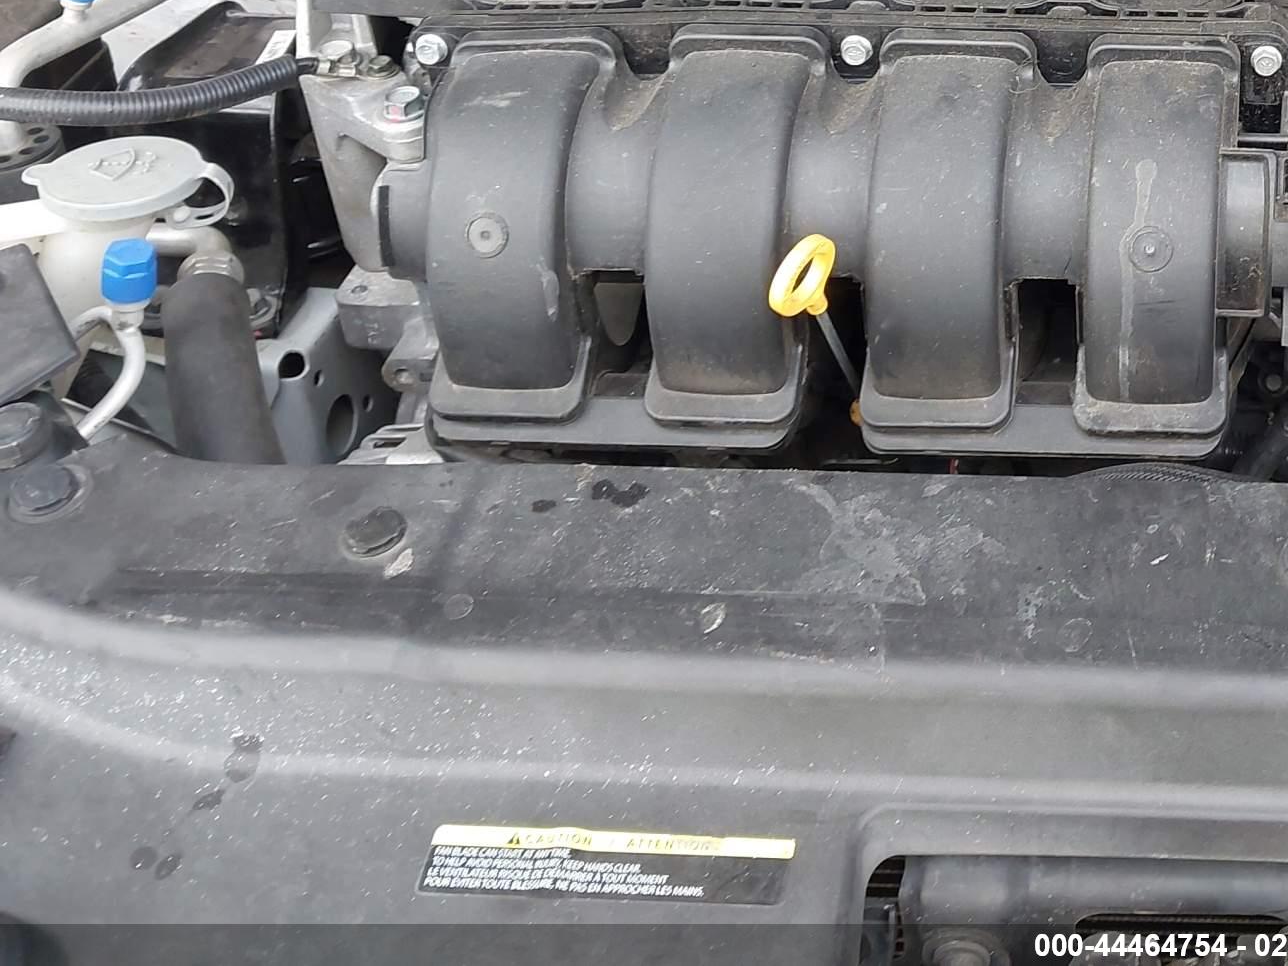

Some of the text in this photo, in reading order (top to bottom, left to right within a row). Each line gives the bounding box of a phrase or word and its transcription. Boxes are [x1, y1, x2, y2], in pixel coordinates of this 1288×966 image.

[525, 833, 592, 846] CAUTION
[434, 846, 452, 857] FAN
[452, 846, 479, 858] BLADE
[479, 847, 498, 859] CAN
[497, 848, 523, 859] START
[522, 849, 534, 859] AT
[432, 856, 445, 867] TO
[444, 856, 466, 868] HELP
[465, 857, 492, 868] AVOID
[491, 858, 534, 870] PERSONAL
[562, 859, 585, 871] KEEP
[583, 861, 614, 873] HANDS
[427, 866, 440, 877] LE
[439, 867, 498, 879] VENTILATEUR
[531, 869, 543, 879] DE
[601, 872, 627, 884] TOUT
[626, 874, 670, 885] MOMENT
[423, 876, 451, 888] POUR
[481, 878, 511, 890] TOUTE
[554, 880, 570, 891] NE
[569, 882, 588, 893] PAS
[600, 883, 656, 895] APPROCHER
[655, 885, 672, 896] LES
